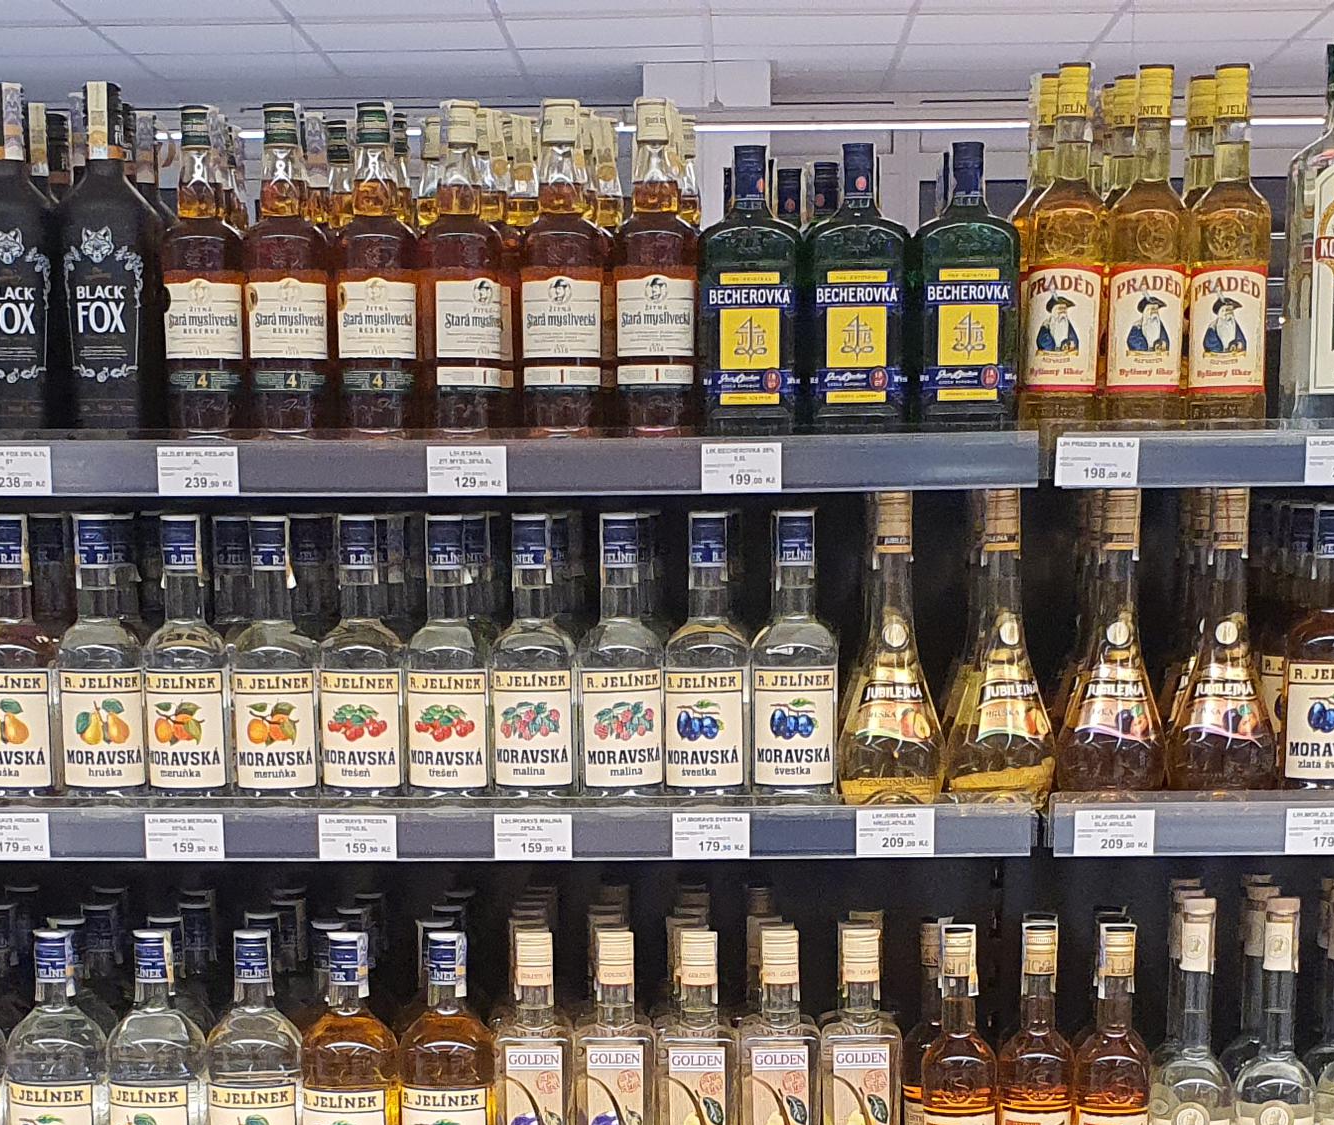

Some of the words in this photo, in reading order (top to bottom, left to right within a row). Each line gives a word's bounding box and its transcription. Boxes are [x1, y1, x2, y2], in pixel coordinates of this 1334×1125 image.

[76, 285, 127, 299] BLACK
[1030, 273, 1095, 299] PRADĚD
[1117, 273, 1182, 298] PRADĚD
[709, 288, 790, 305] BECHEROVKA
[817, 287, 896, 303] BECHEROVKA
[928, 286, 1009, 301] BECHEROVKA
[77, 302, 126, 334] FOX
[254, 312, 276, 328] Stará
[278, 311, 324, 328] myslivecká
[79, 674, 140, 689] JELÍNEK
[249, 676, 309, 689] JELÍNEK
[421, 676, 481, 690] JELÍNEK
[601, 673, 658, 688] JELÍNEK
[769, 673, 829, 688] JELÍNEK
[67, 747, 143, 765] MORAVSKÁ
[239, 749, 313, 767] MORAVSKÁ
[588, 746, 660, 765] MORAVSKÁ
[757, 744, 831, 763] MORAVSKÁ
[88, 767, 122, 777] hruška
[513, 767, 545, 776] malina
[610, 766, 643, 776] malina
[774, 765, 811, 775] švestka
[508, 1052, 560, 1066] GOLDEN
[589, 1051, 640, 1065] GOLDEN
[672, 1053, 722, 1067] GOLDEN
[755, 1052, 806, 1066] GOLDEN
[836, 1050, 887, 1064] GOLDEN
